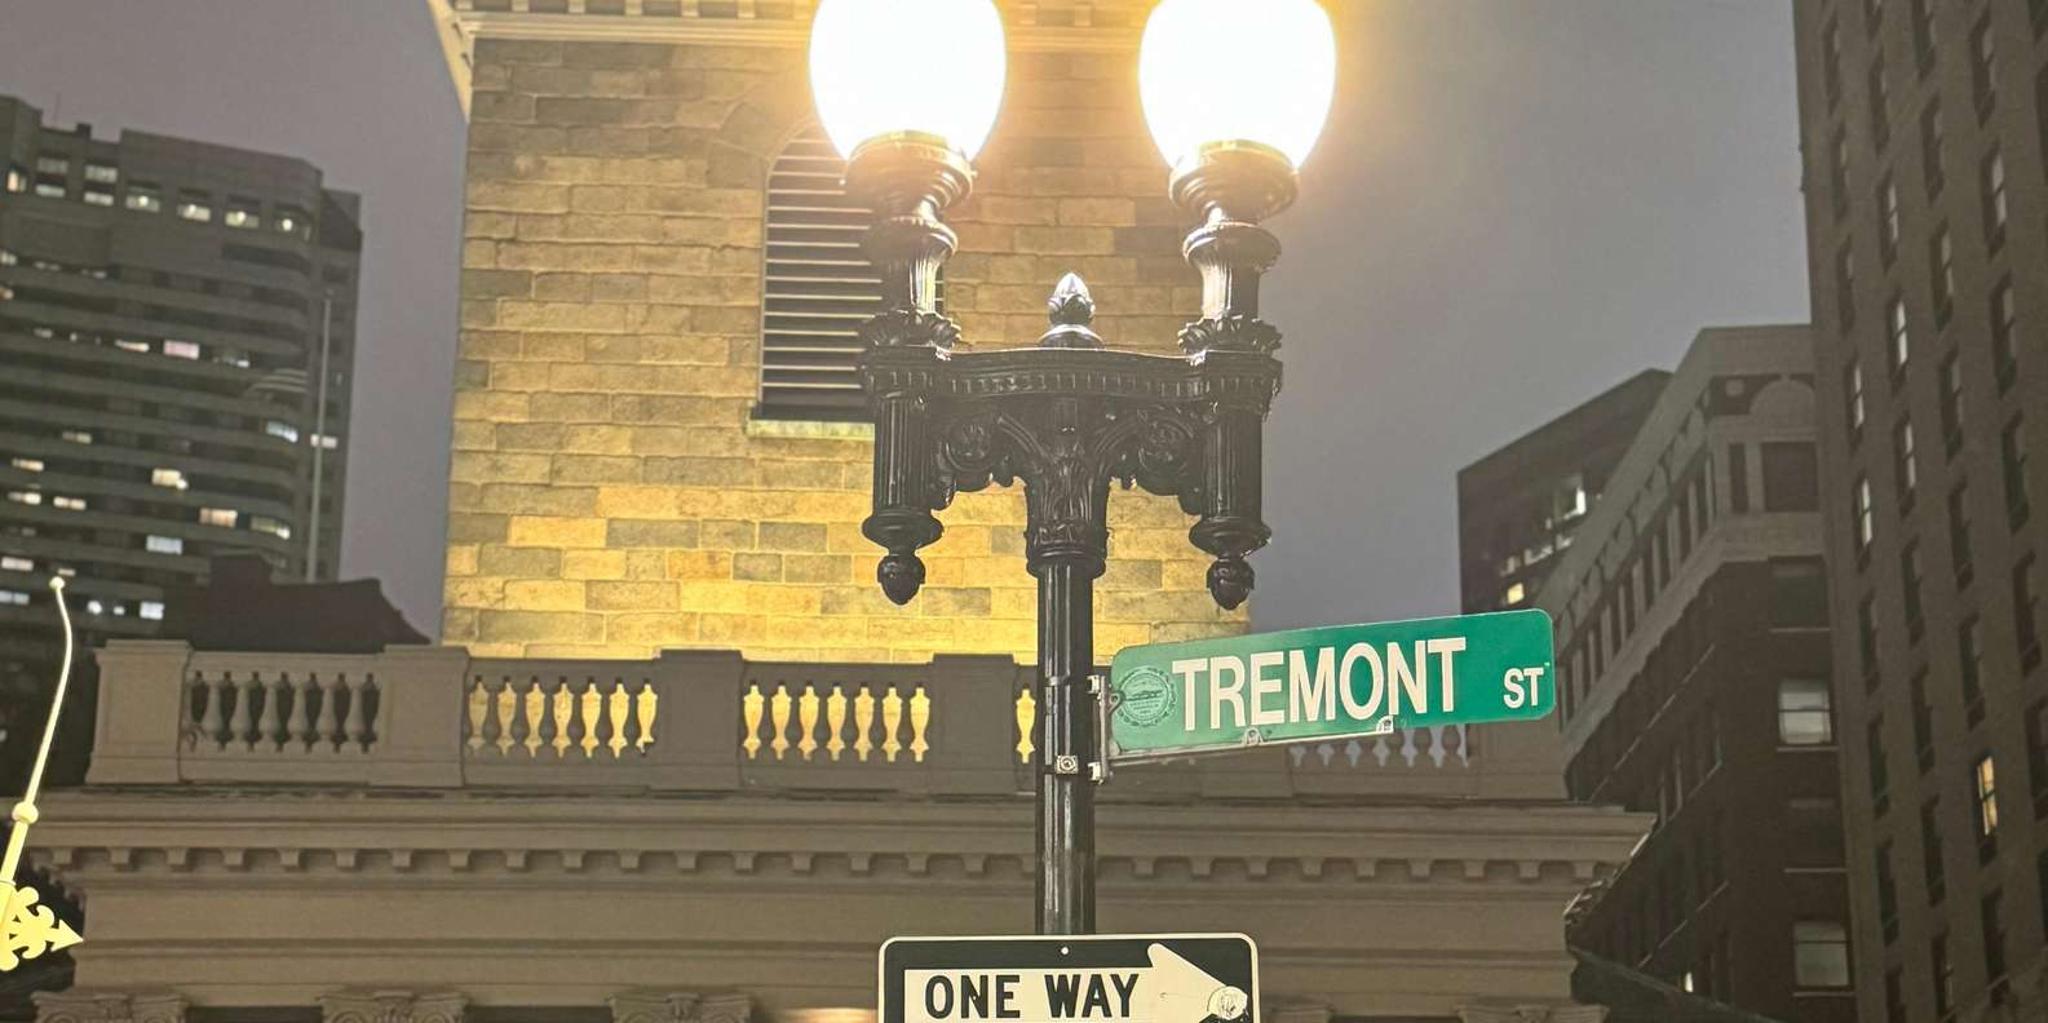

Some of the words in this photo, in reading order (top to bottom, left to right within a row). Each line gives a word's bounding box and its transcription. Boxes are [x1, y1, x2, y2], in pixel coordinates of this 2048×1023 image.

[1172, 637, 1466, 731] TREMONT
[1503, 667, 1544, 708] ST
[925, 975, 1020, 1019] ONE
[1044, 973, 1139, 1018] WAY
